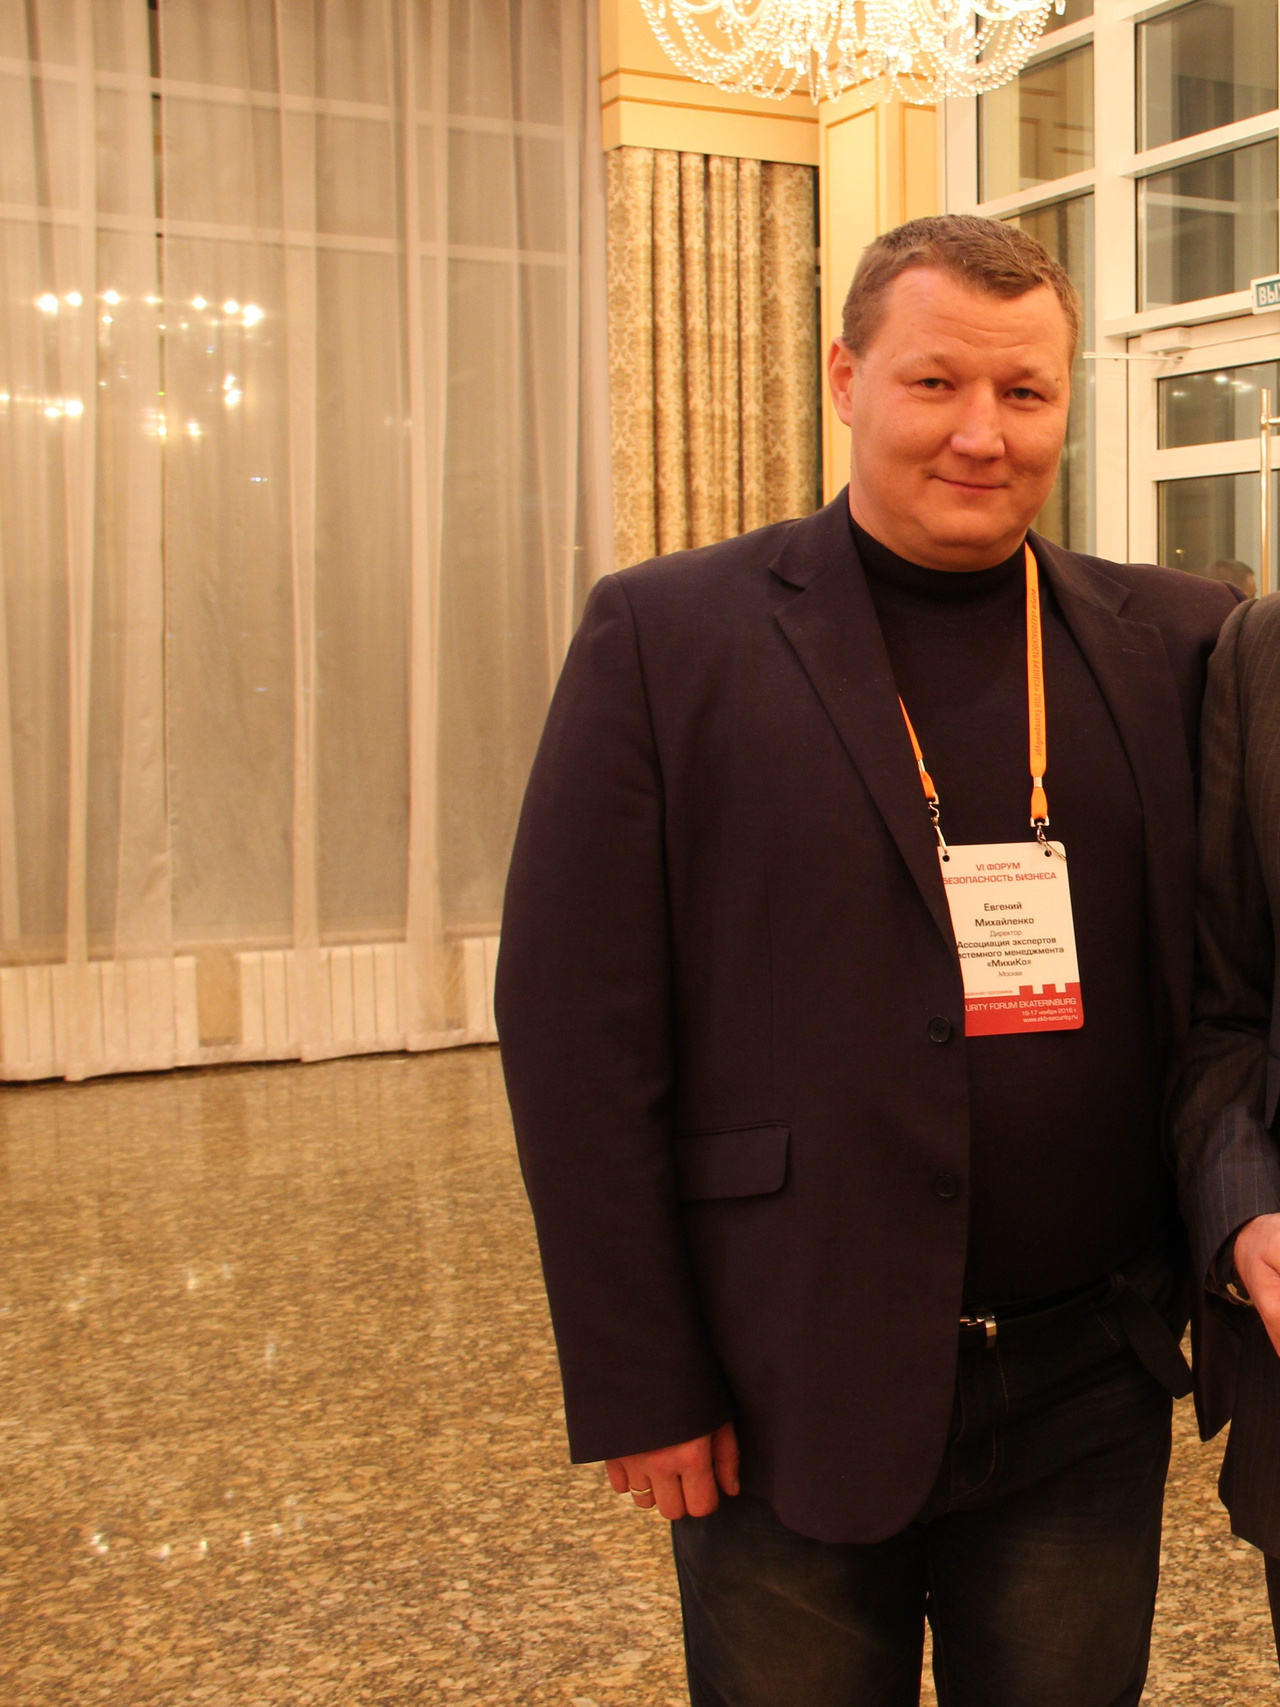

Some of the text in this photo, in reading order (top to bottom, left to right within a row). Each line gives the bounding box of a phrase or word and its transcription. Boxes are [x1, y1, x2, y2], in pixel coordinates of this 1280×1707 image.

[986, 862, 1021, 871] ФОРУМ
[943, 872, 1057, 885] БЕЗОПАСНОСТЬ БИЗНЕСА
[984, 902, 1022, 912] Евгений
[975, 917, 1034, 927] Михайленко
[989, 930, 1022, 938] Директор
[957, 937, 1056, 949] Ассоциация экспертов
[1004, 947, 1064, 956] менеджмента
[989, 1001, 1018, 1010] FORUM
[1019, 998, 1077, 1008] EKATERINBURG
